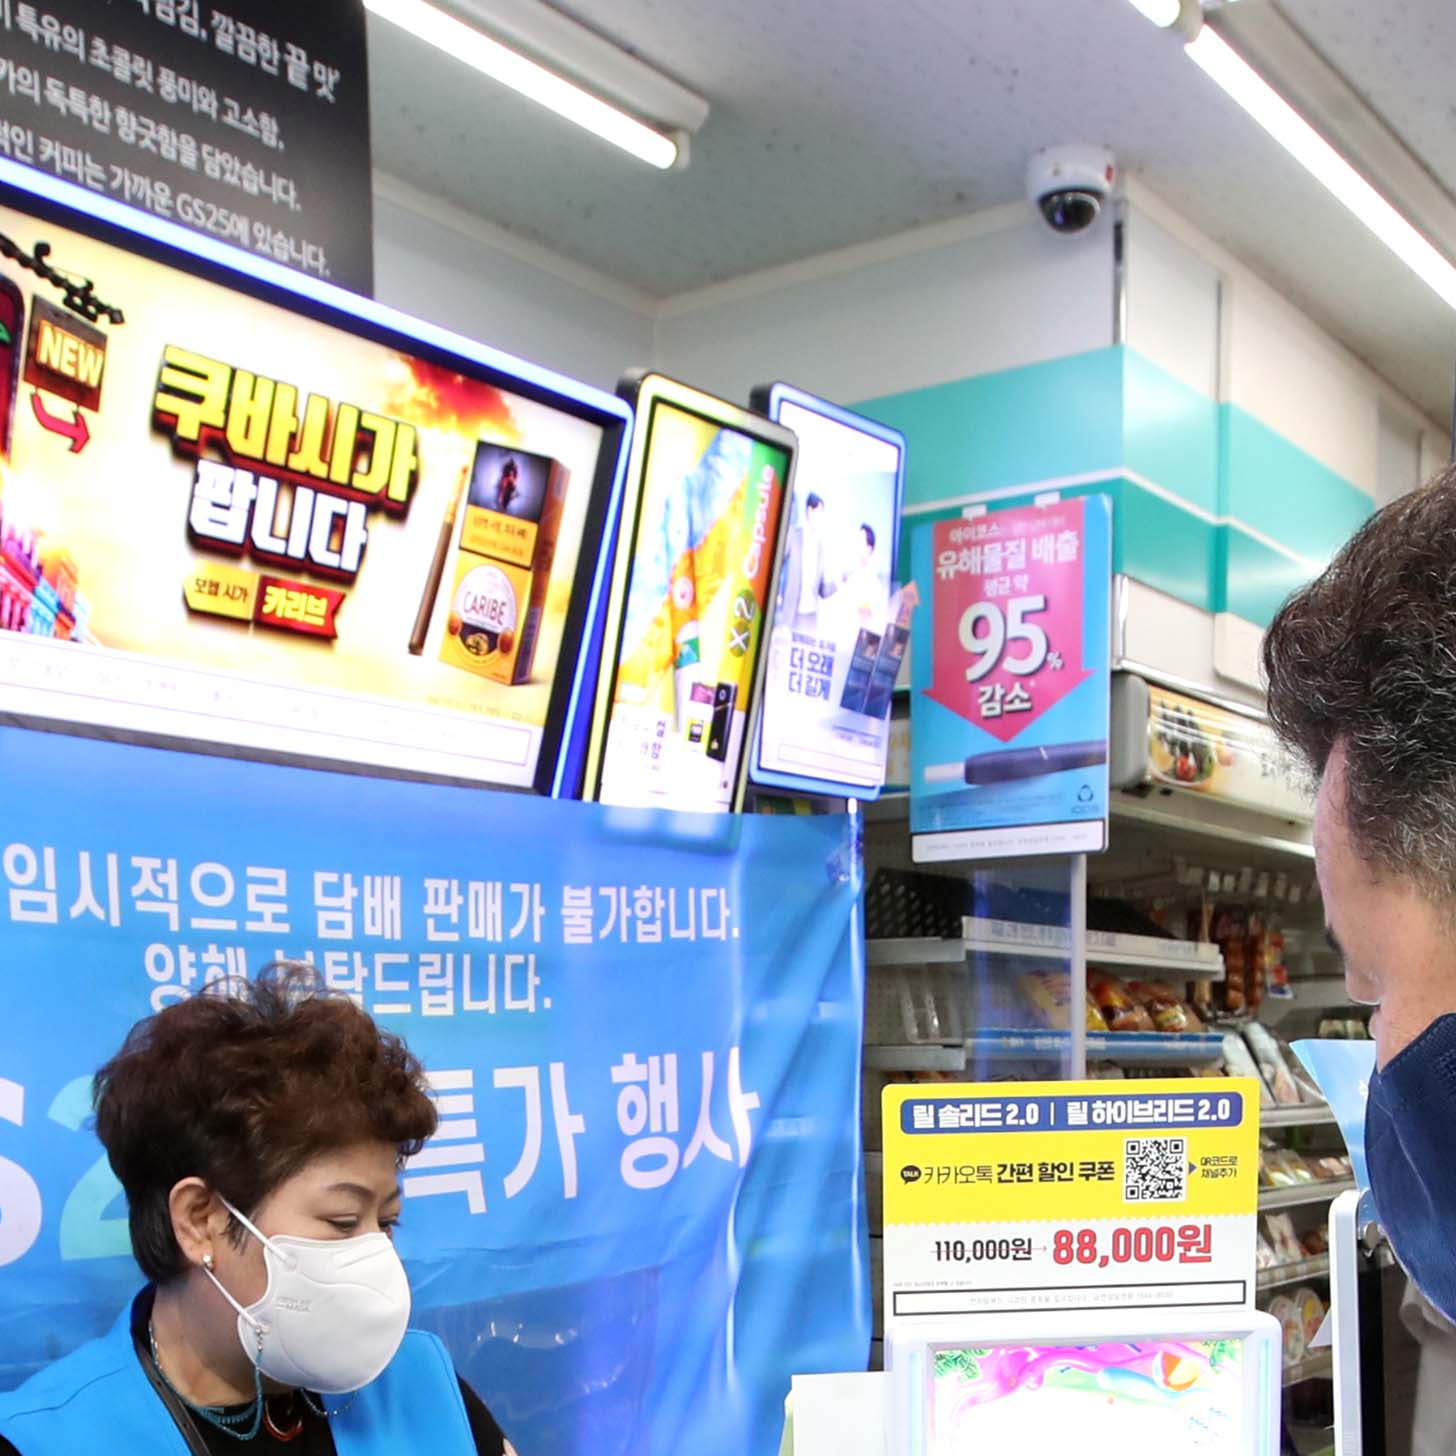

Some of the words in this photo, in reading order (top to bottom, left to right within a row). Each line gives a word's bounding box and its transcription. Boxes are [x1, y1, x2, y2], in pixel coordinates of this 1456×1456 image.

[16, 2, 86, 64] 특유의
[89, 36, 155, 94] 초콜릿
[156, 65, 219, 122] 풍미와
[221, 96, 286, 151] 고소함,
[211, 9, 280, 77] 깔끔한
[283, 42, 310, 92] 끝
[45, 75, 113, 137] 독특한
[114, 104, 200, 171] 향긋함을
[200, 142, 303, 212] 담았습니다.
[38, 136, 109, 192] 커피는
[109, 165, 175, 217] 가까운
[175, 194, 251, 246] GS25에
[252, 219, 331, 277] 있습니다.
[35, 317, 105, 389] NEW
[152, 343, 420, 508] 쿠바시가
[936, 537, 1027, 581] 유해물질
[1031, 529, 1079, 564] 배출
[260, 585, 330, 627] 카리브
[462, 590, 508, 626] CARIBE
[977, 682, 1033, 720] 감소
[0, 842, 292, 936] 임시적으로
[312, 870, 404, 943] 담배
[422, 878, 547, 948] 판매가
[559, 883, 742, 947] 불가합니다.
[402, 1060, 586, 1215] 특가
[611, 1046, 763, 1191] 행사
[912, 1104, 935, 1130] 릴
[937, 1101, 1003, 1129] 솔리드
[1005, 1101, 1039, 1127] 2.0
[1066, 1099, 1089, 1126] 릴
[1091, 1098, 1195, 1126] 하이브리드
[1197, 1097, 1231, 1122] 2.0
[923, 1164, 993, 1186] 카카오톡
[996, 1162, 1035, 1185] 간편
[1038, 1160, 1075, 1184] 할인
[1078, 1160, 1115, 1183] 쿠폰
[933, 1237, 1033, 1263] 110,000원
[1051, 1223, 1213, 1269] 88,000원
